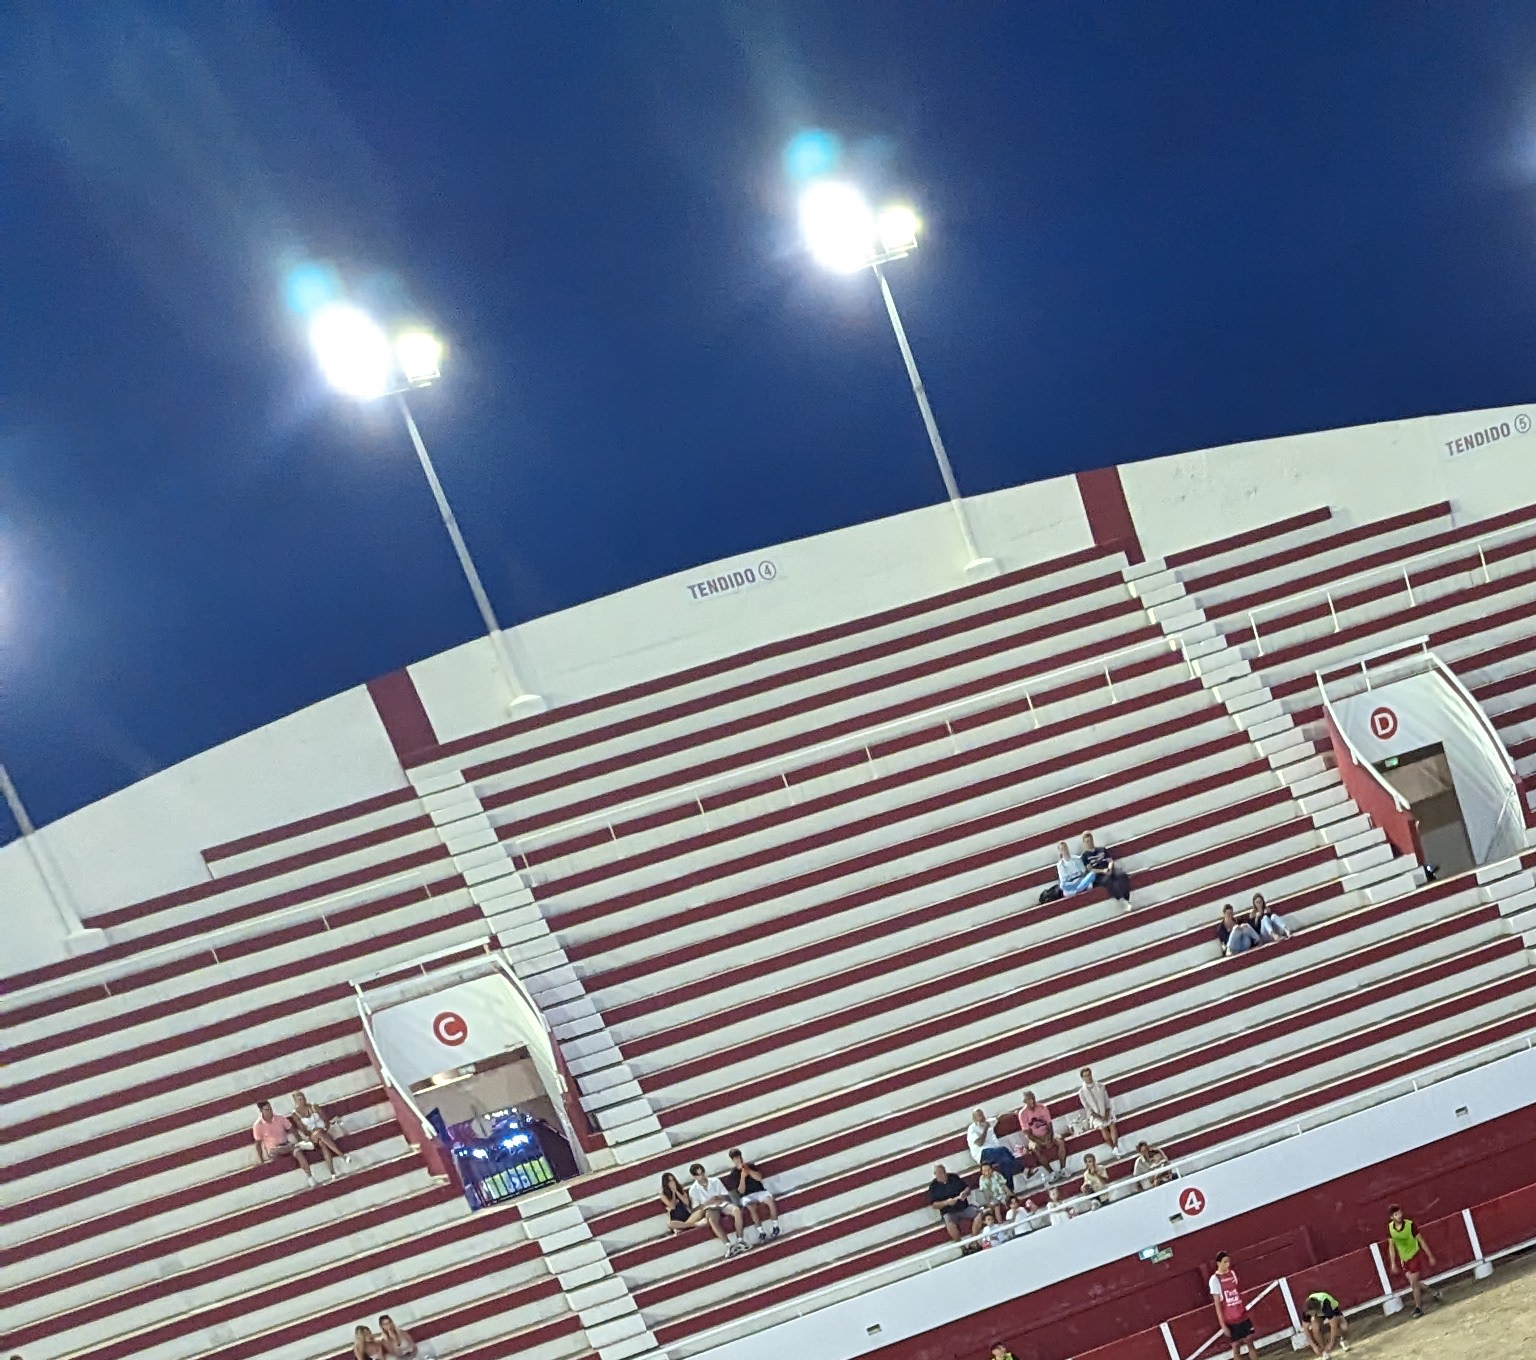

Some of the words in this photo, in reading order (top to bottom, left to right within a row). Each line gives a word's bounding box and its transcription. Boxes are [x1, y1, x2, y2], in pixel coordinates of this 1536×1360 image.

[1446, 422, 1511, 456] TENDIDO
[687, 568, 756, 600] TENDIDO
[1373, 712, 1394, 736] D
[438, 1016, 464, 1041] C
[1183, 1190, 1203, 1211] 4
